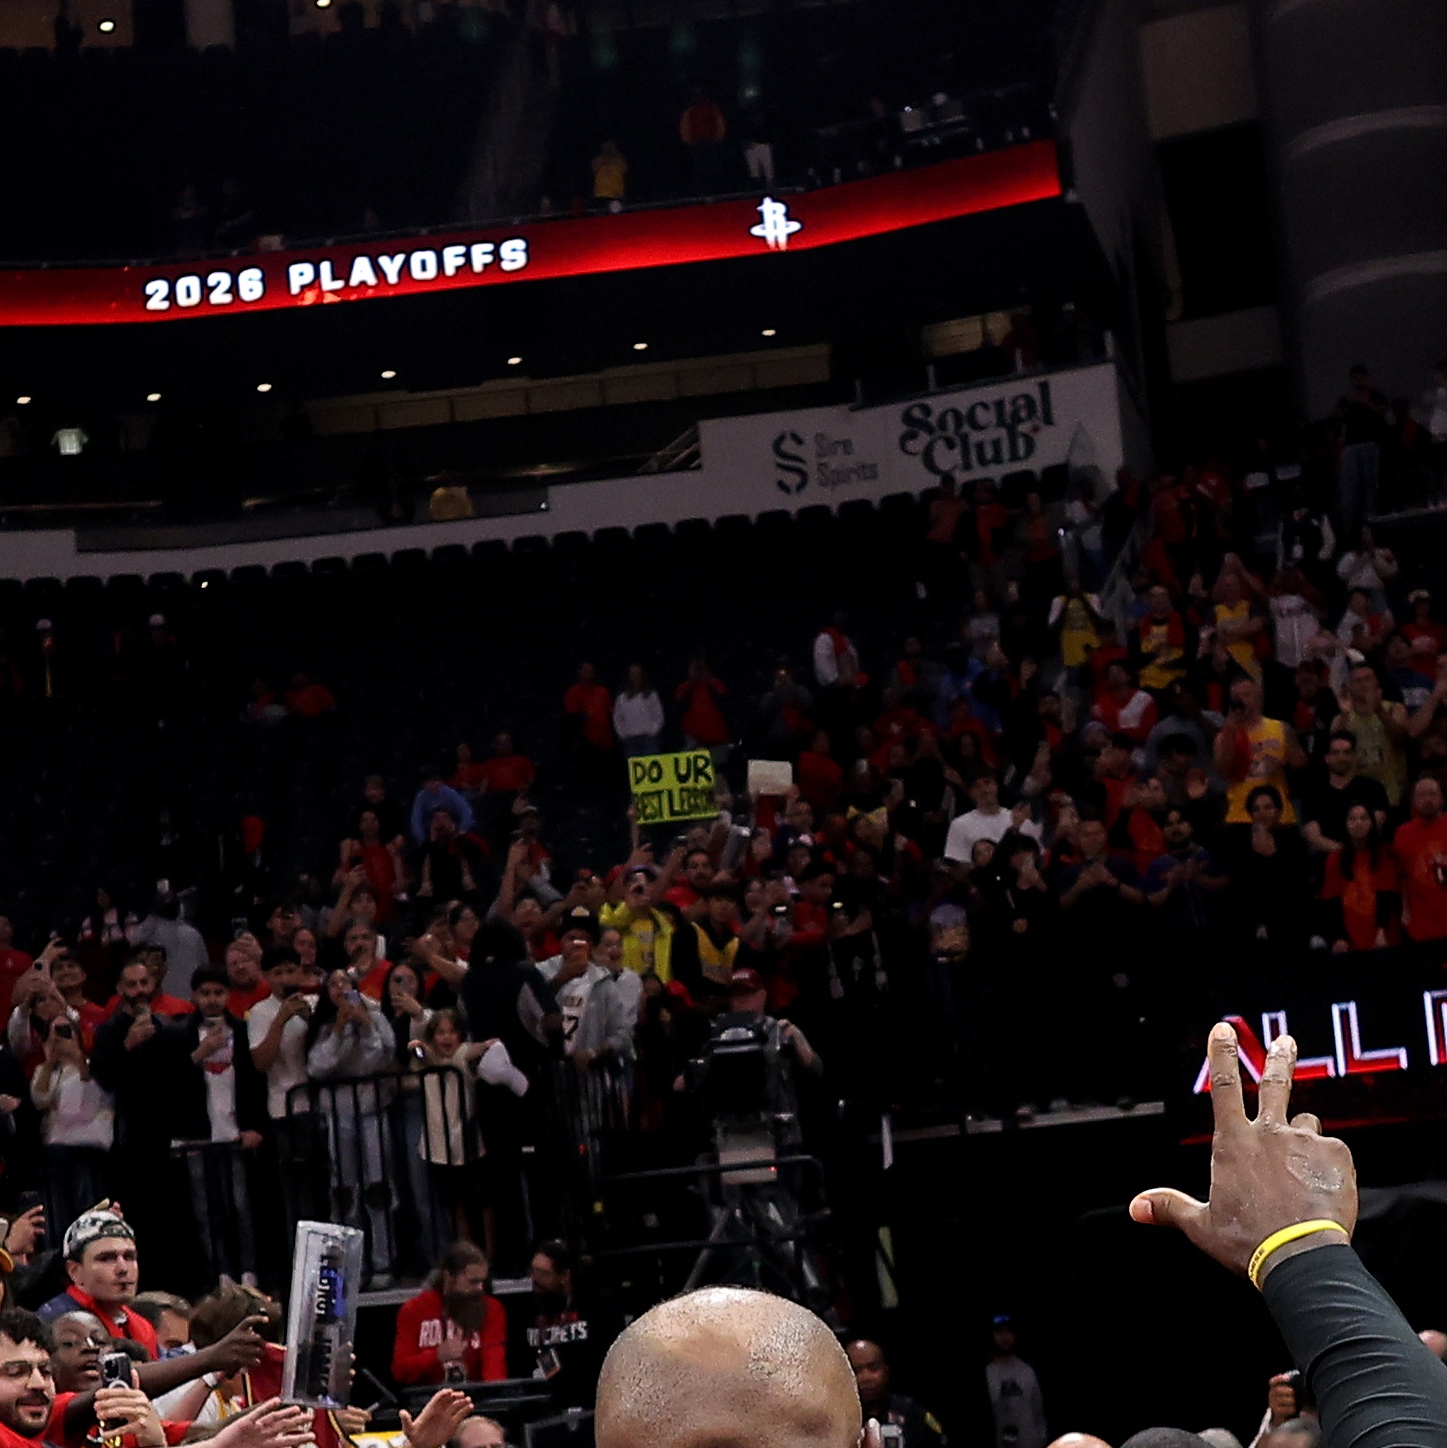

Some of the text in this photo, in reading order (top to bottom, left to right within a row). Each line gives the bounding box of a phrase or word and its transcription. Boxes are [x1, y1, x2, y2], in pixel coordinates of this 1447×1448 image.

[145, 238, 527, 310] 2026 PLAYOFFS
[900, 381, 1053, 455] Social
[923, 415, 1035, 475] Club
[633, 755, 712, 784] DO UR
